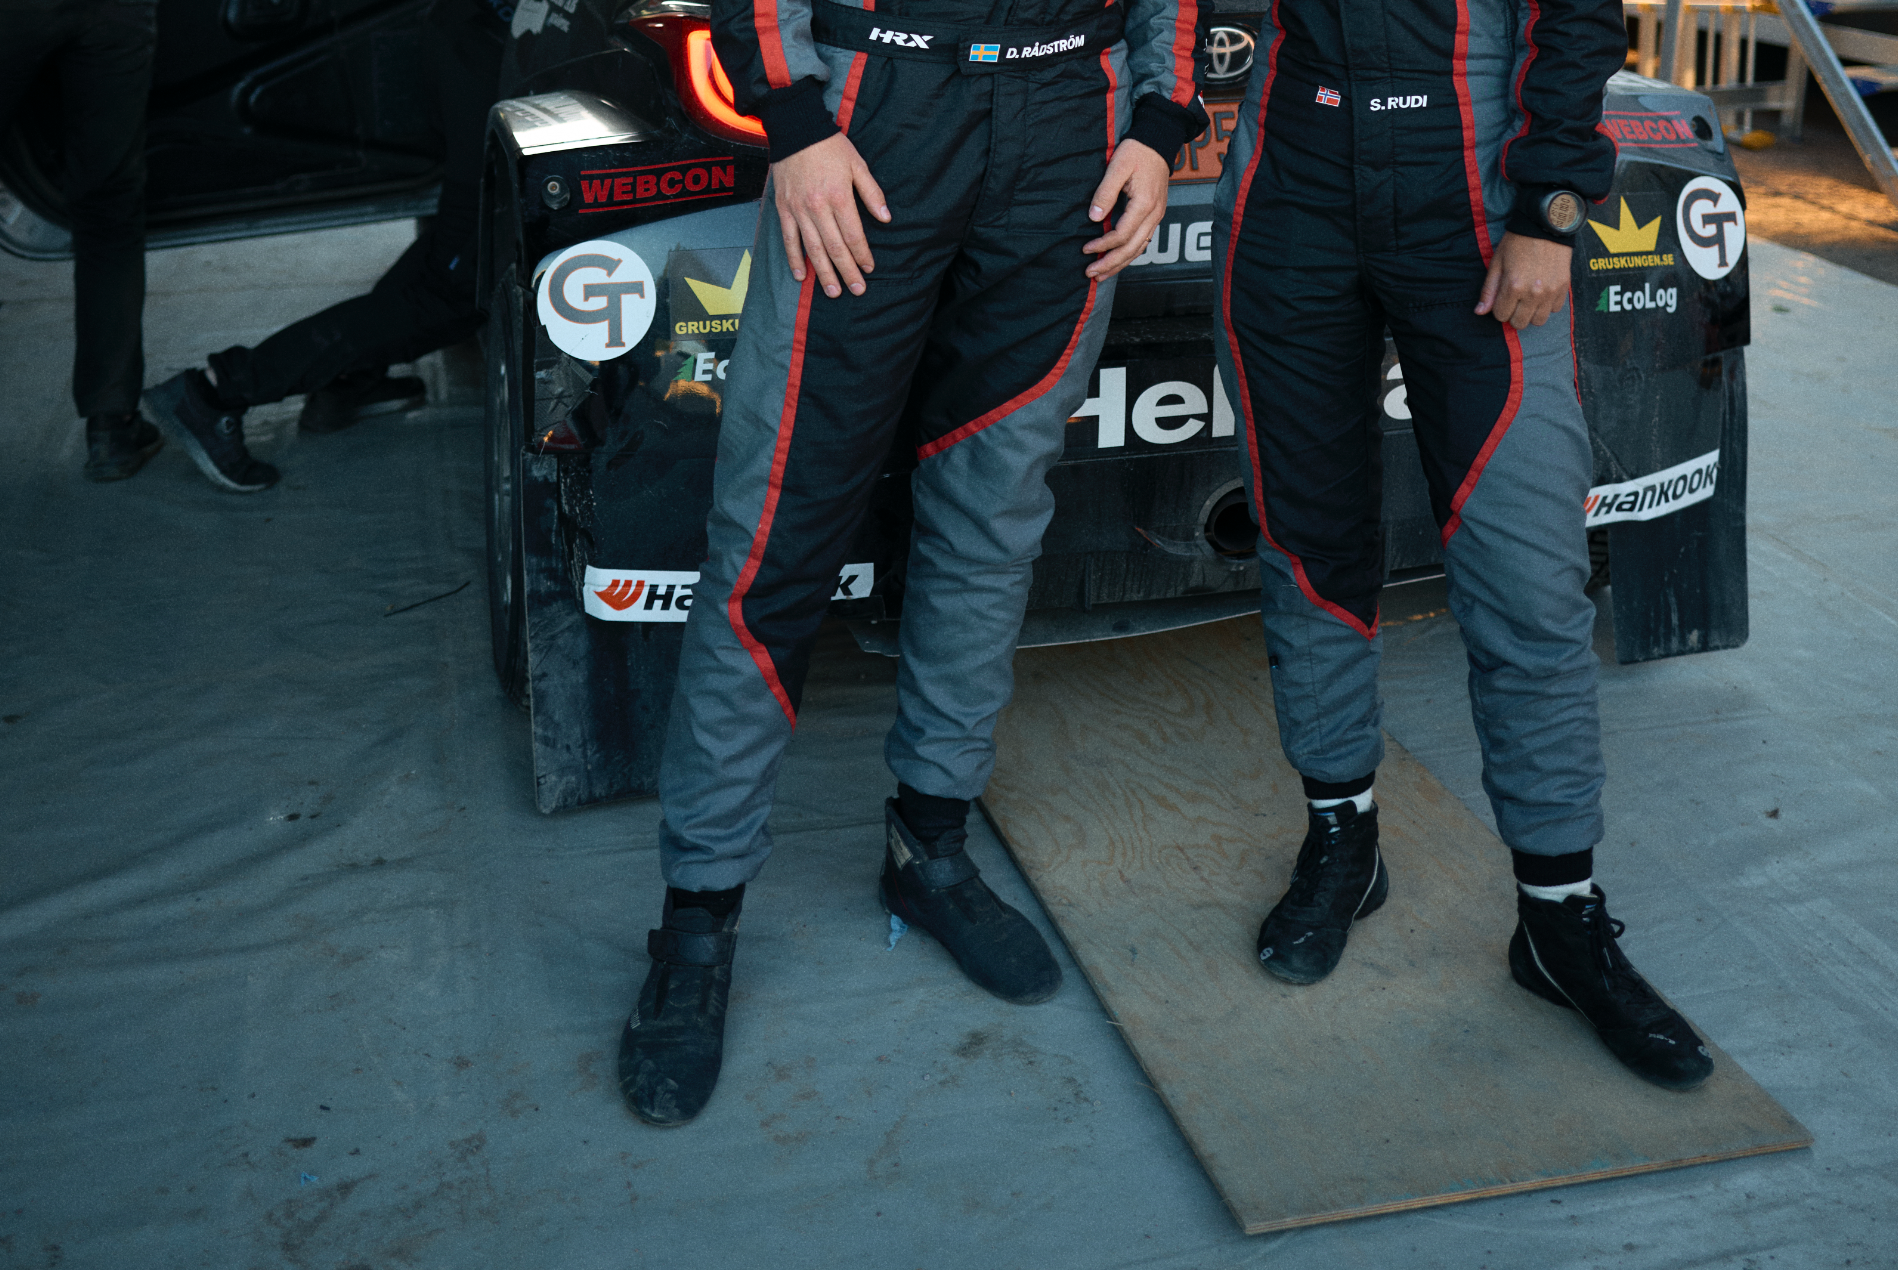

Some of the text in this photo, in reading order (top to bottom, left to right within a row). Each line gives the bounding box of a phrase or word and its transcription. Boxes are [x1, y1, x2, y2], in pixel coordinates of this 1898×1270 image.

[869, 28, 934, 49] HRX
[1021, 34, 1085, 58] RÅDSTRÖM
[1605, 118, 1695, 141] WEBCON
[580, 165, 735, 204] WEBCON
[1682, 188, 1738, 269] GT
[1589, 254, 1674, 271] GRUSKUNGEN.SE
[548, 253, 645, 348] GT
[1608, 282, 1677, 314] EcoLog
